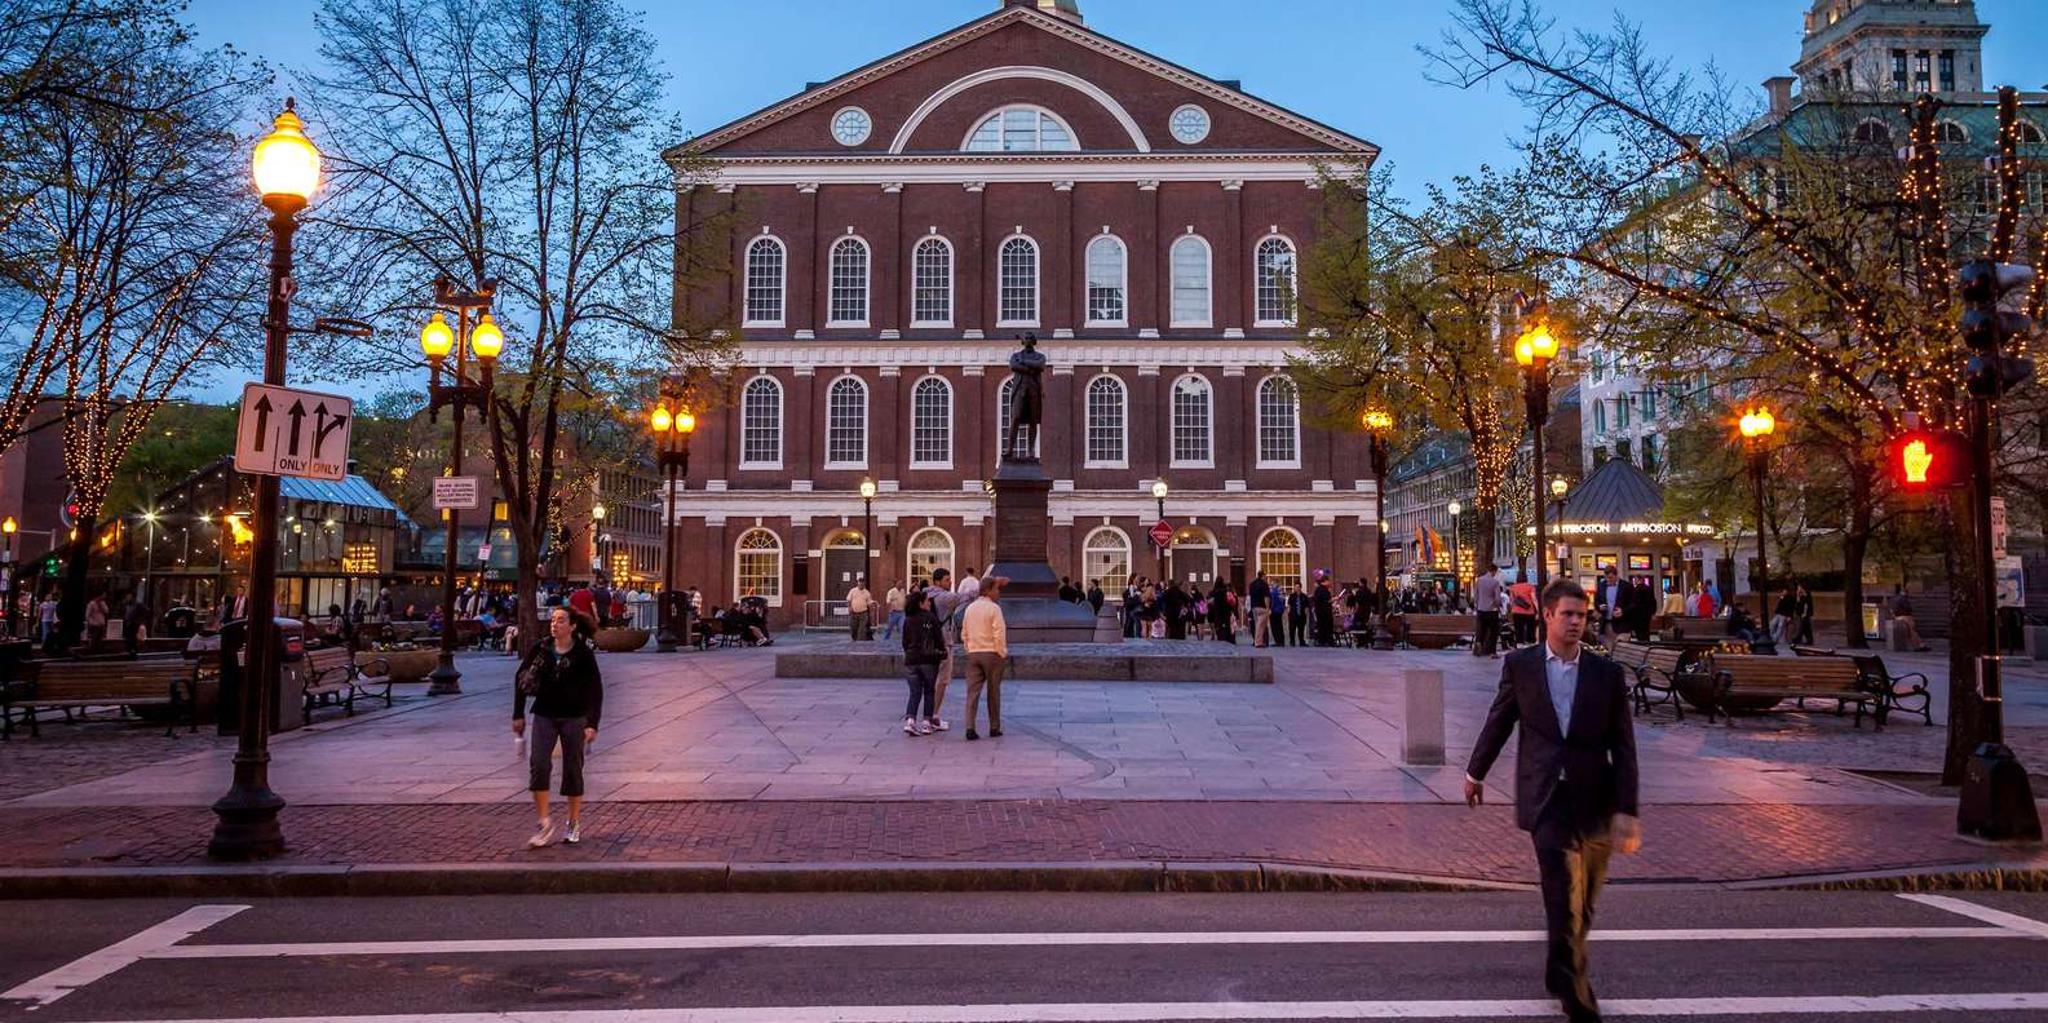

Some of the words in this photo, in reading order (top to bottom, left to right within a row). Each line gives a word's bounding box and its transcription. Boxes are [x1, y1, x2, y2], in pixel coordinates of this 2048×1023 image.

[280, 459, 307, 471] ONLY
[314, 463, 340, 475] ONLY
[1620, 523, 1681, 533] ARTSBOSTON
